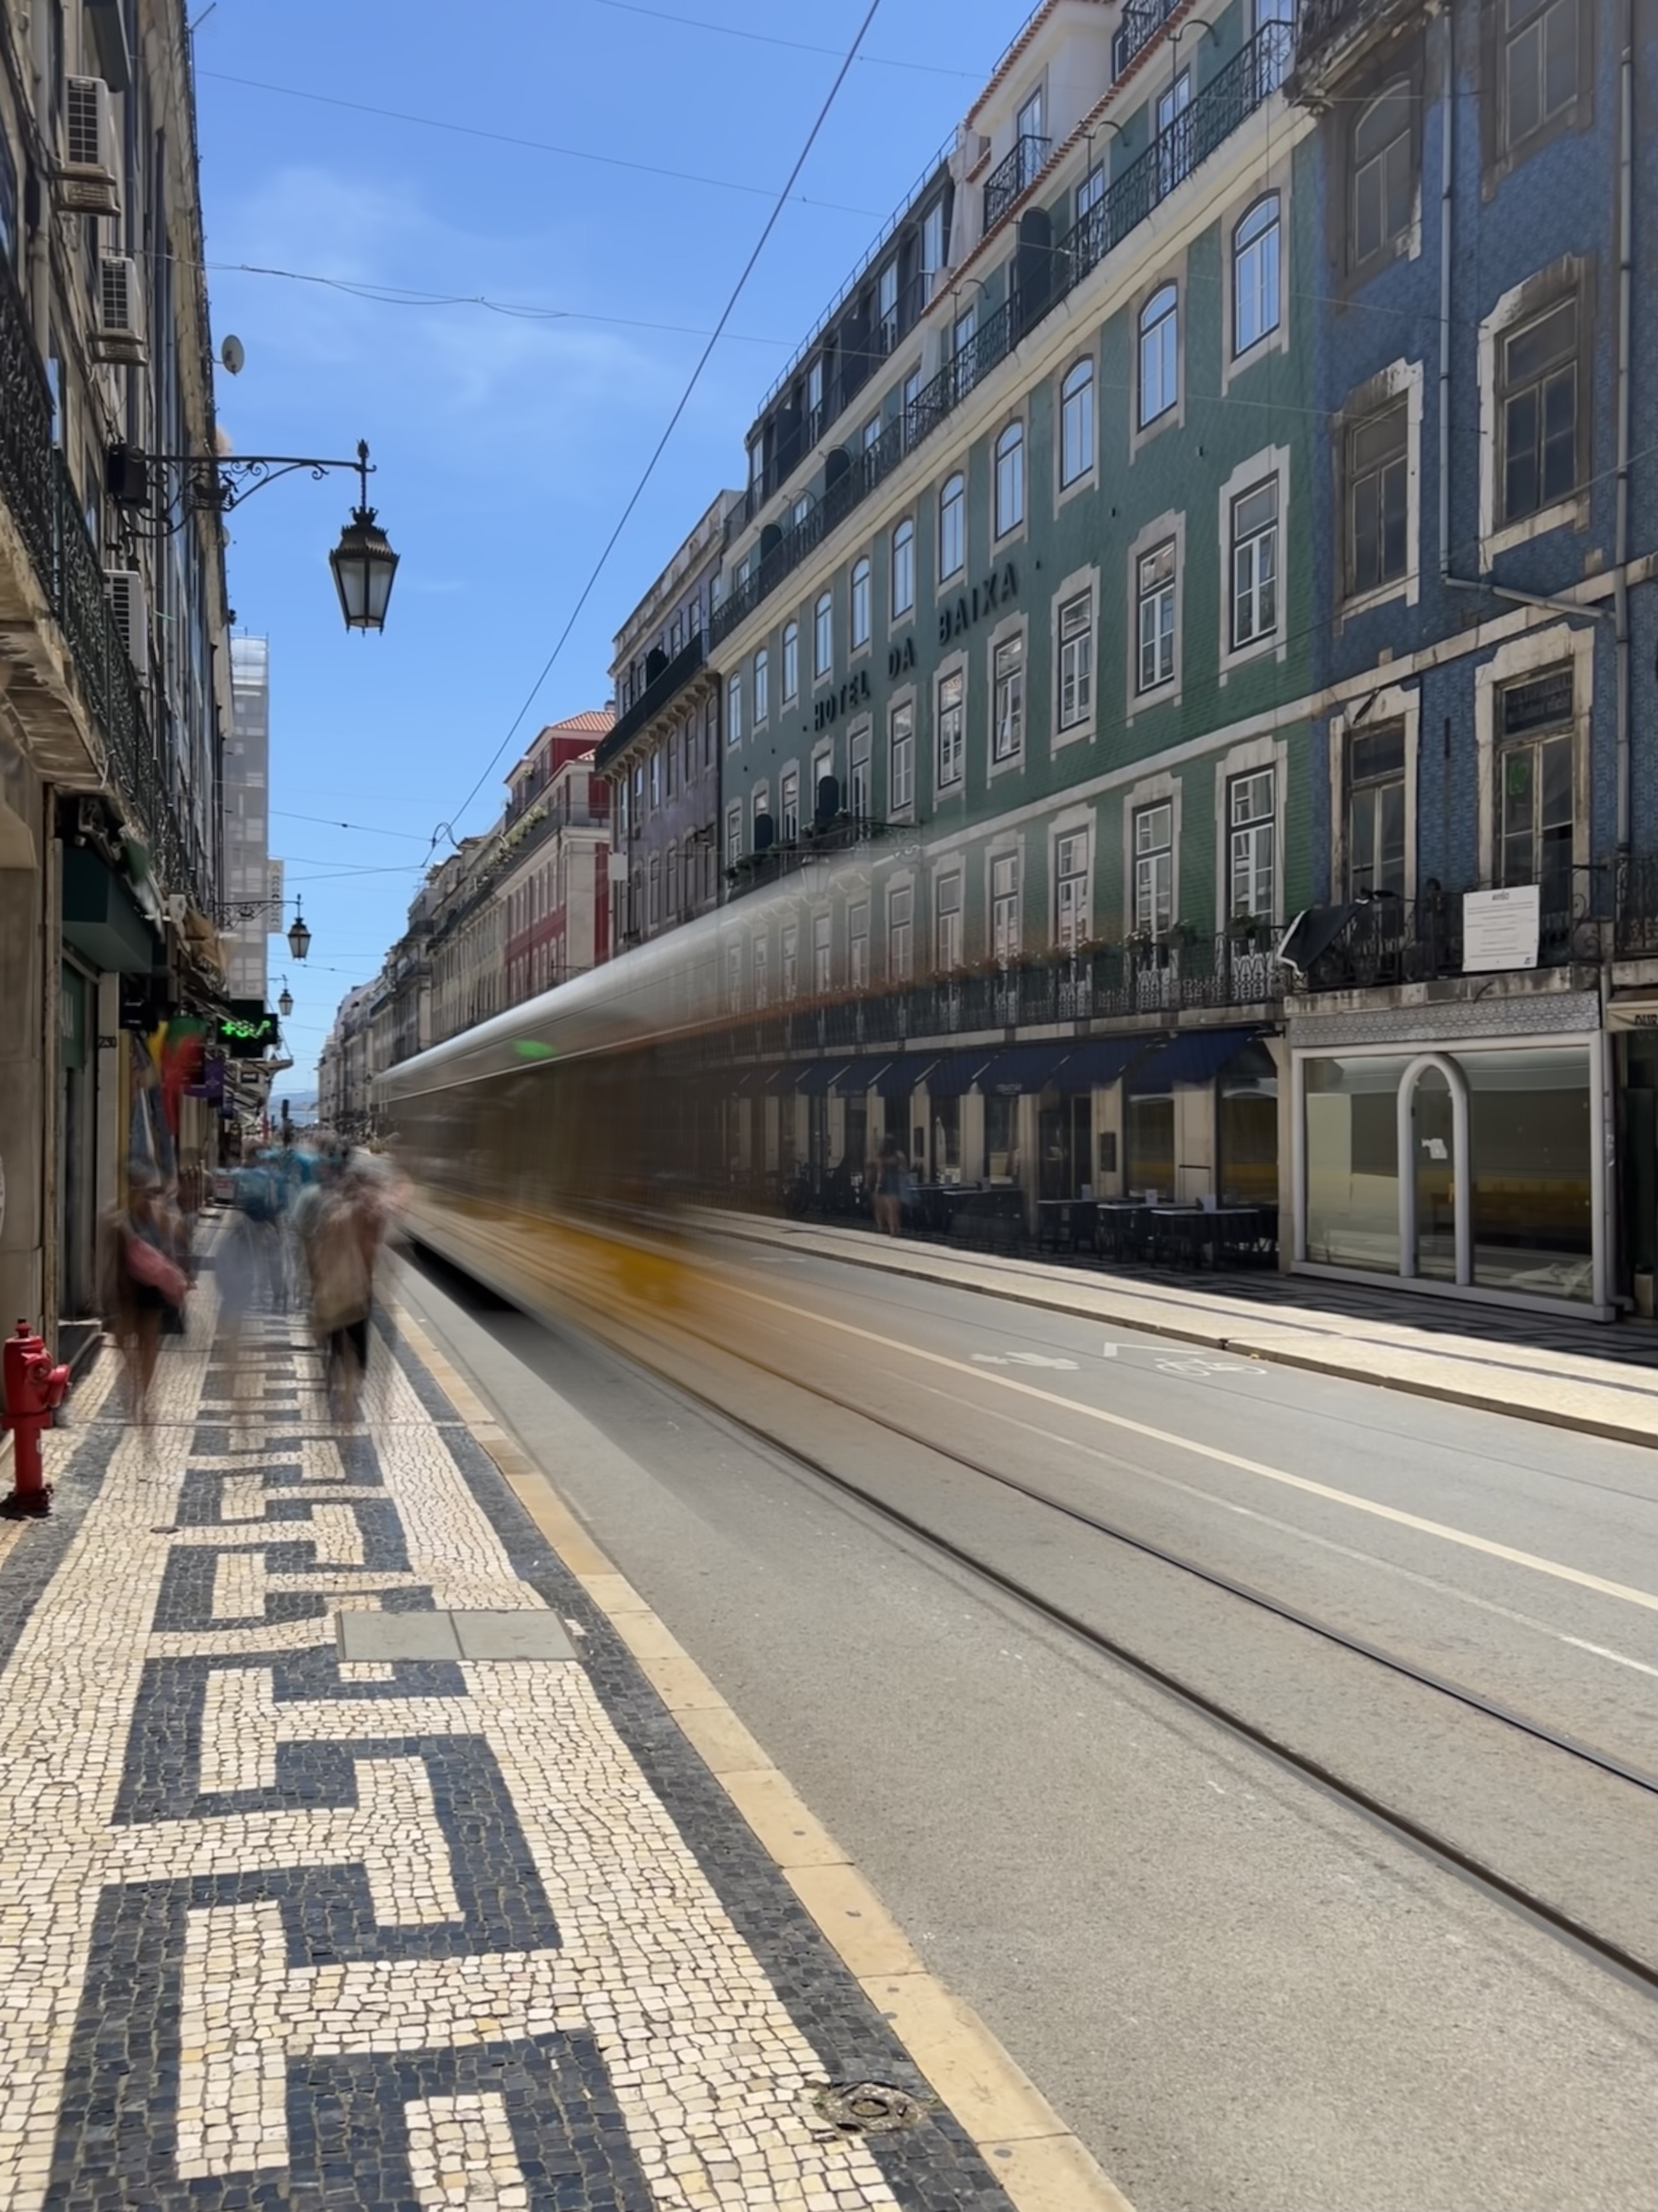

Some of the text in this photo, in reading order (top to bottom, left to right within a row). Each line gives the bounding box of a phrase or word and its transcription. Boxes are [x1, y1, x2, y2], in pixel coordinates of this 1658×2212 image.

[815, 563, 1018, 732] HOTEL DA BAIXA
